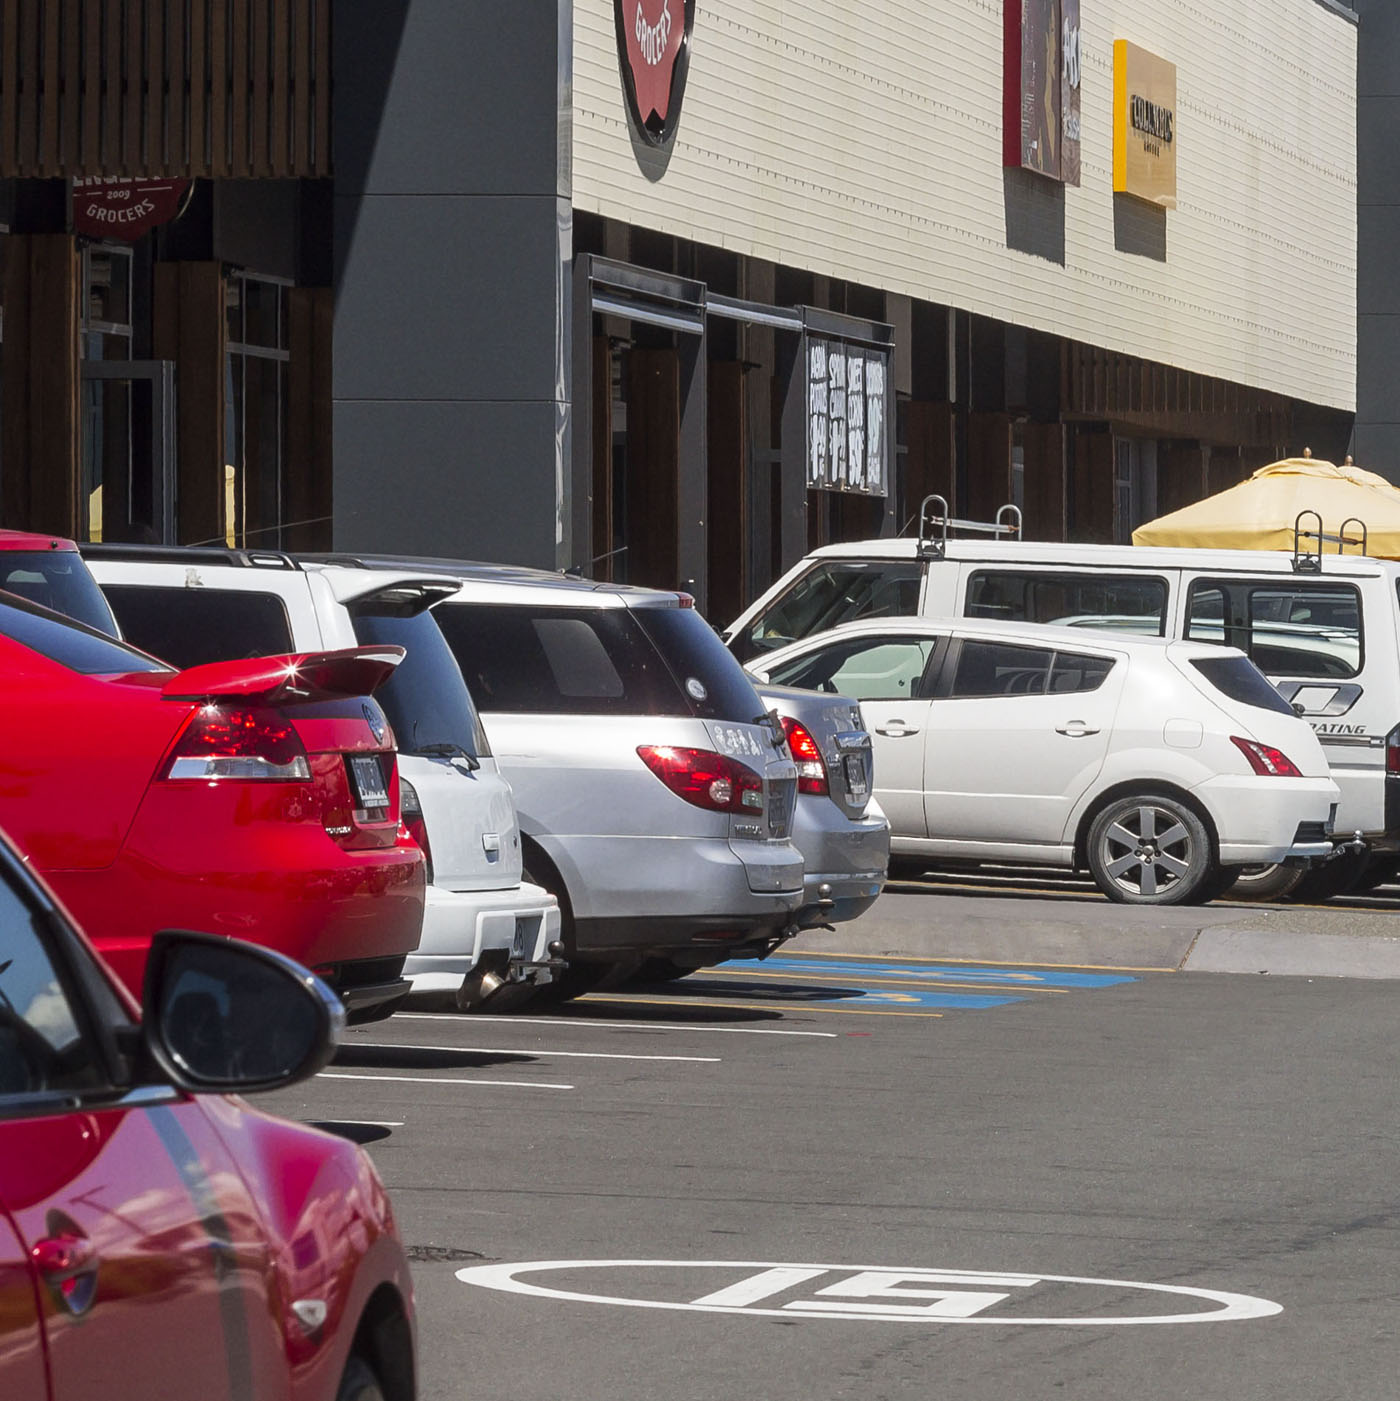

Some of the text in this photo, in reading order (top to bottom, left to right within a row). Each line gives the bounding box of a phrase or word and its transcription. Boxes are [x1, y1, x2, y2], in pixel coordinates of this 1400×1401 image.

[106, 190, 130, 200] 2009
[86, 198, 155, 222] GROCERS
[688, 1266, 1041, 1318] 15
